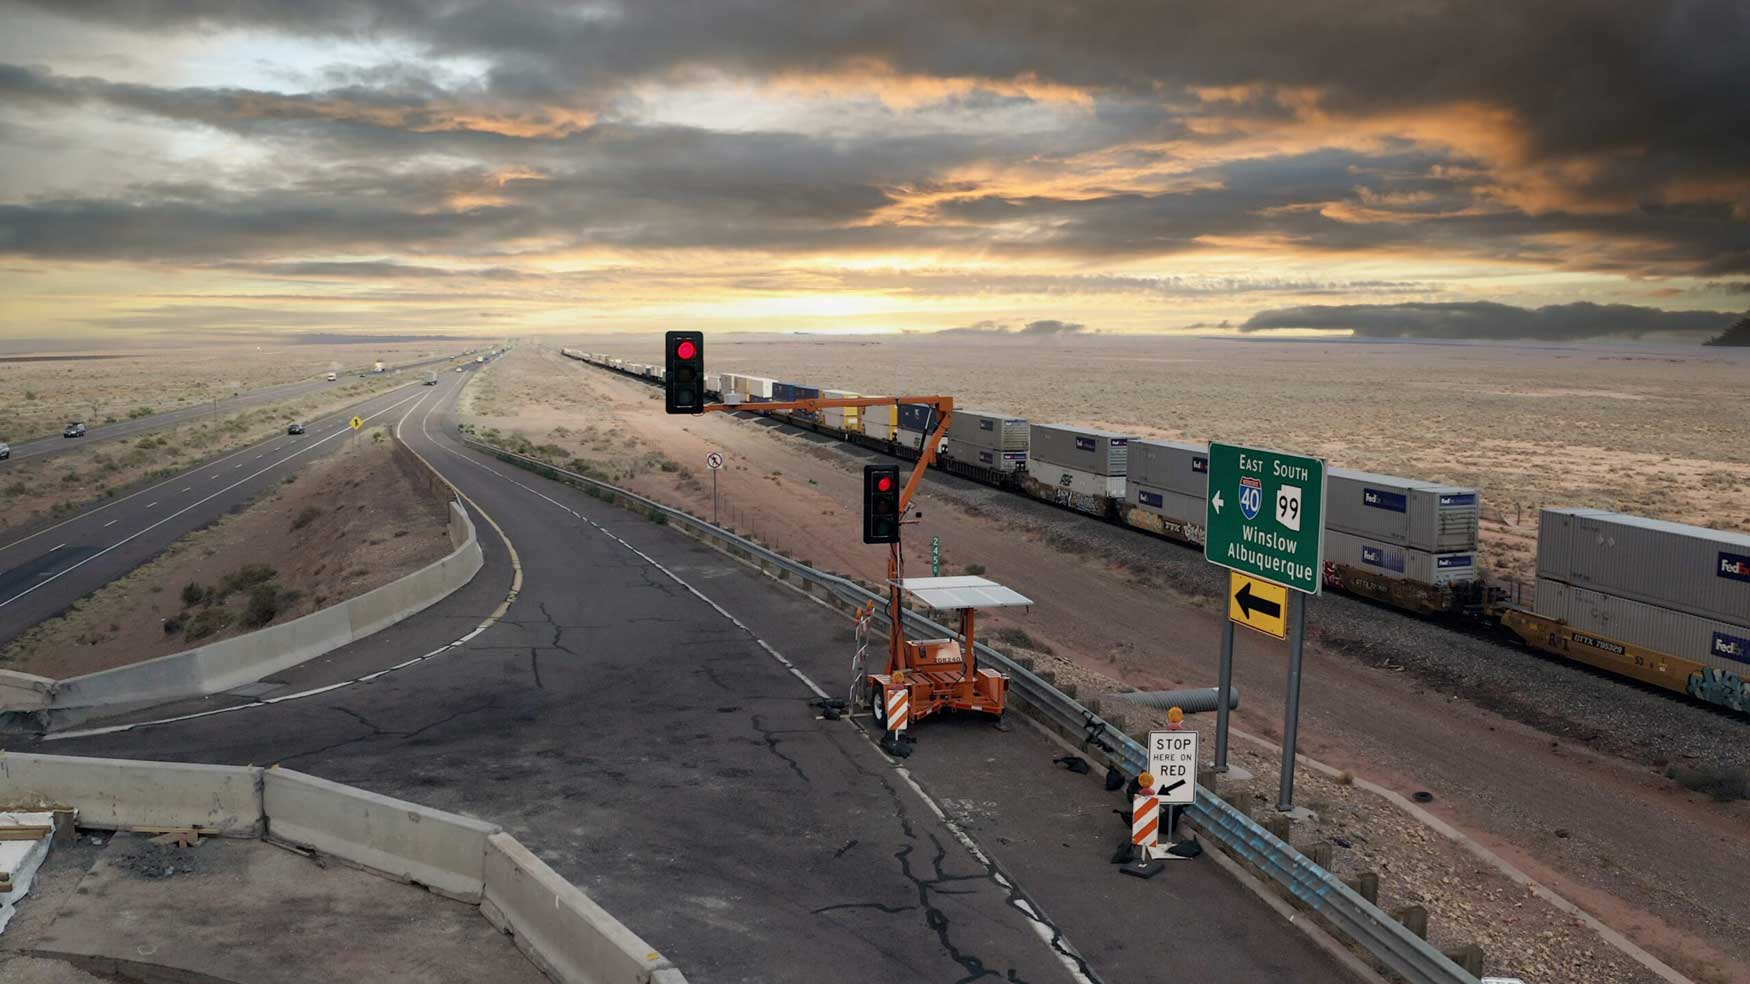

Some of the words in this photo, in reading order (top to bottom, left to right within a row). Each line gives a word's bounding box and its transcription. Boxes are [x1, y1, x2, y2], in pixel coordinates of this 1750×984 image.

[1240, 454, 1264, 473] EAST
[1273, 460, 1308, 481] SOUTH
[1241, 488, 1260, 512] 40
[1279, 495, 1299, 520] 99
[1242, 525, 1297, 554] Winslow
[1227, 542, 1313, 581] Albuquerque
[1156, 738, 1191, 750] STOP
[1160, 765, 1186, 776] RED
